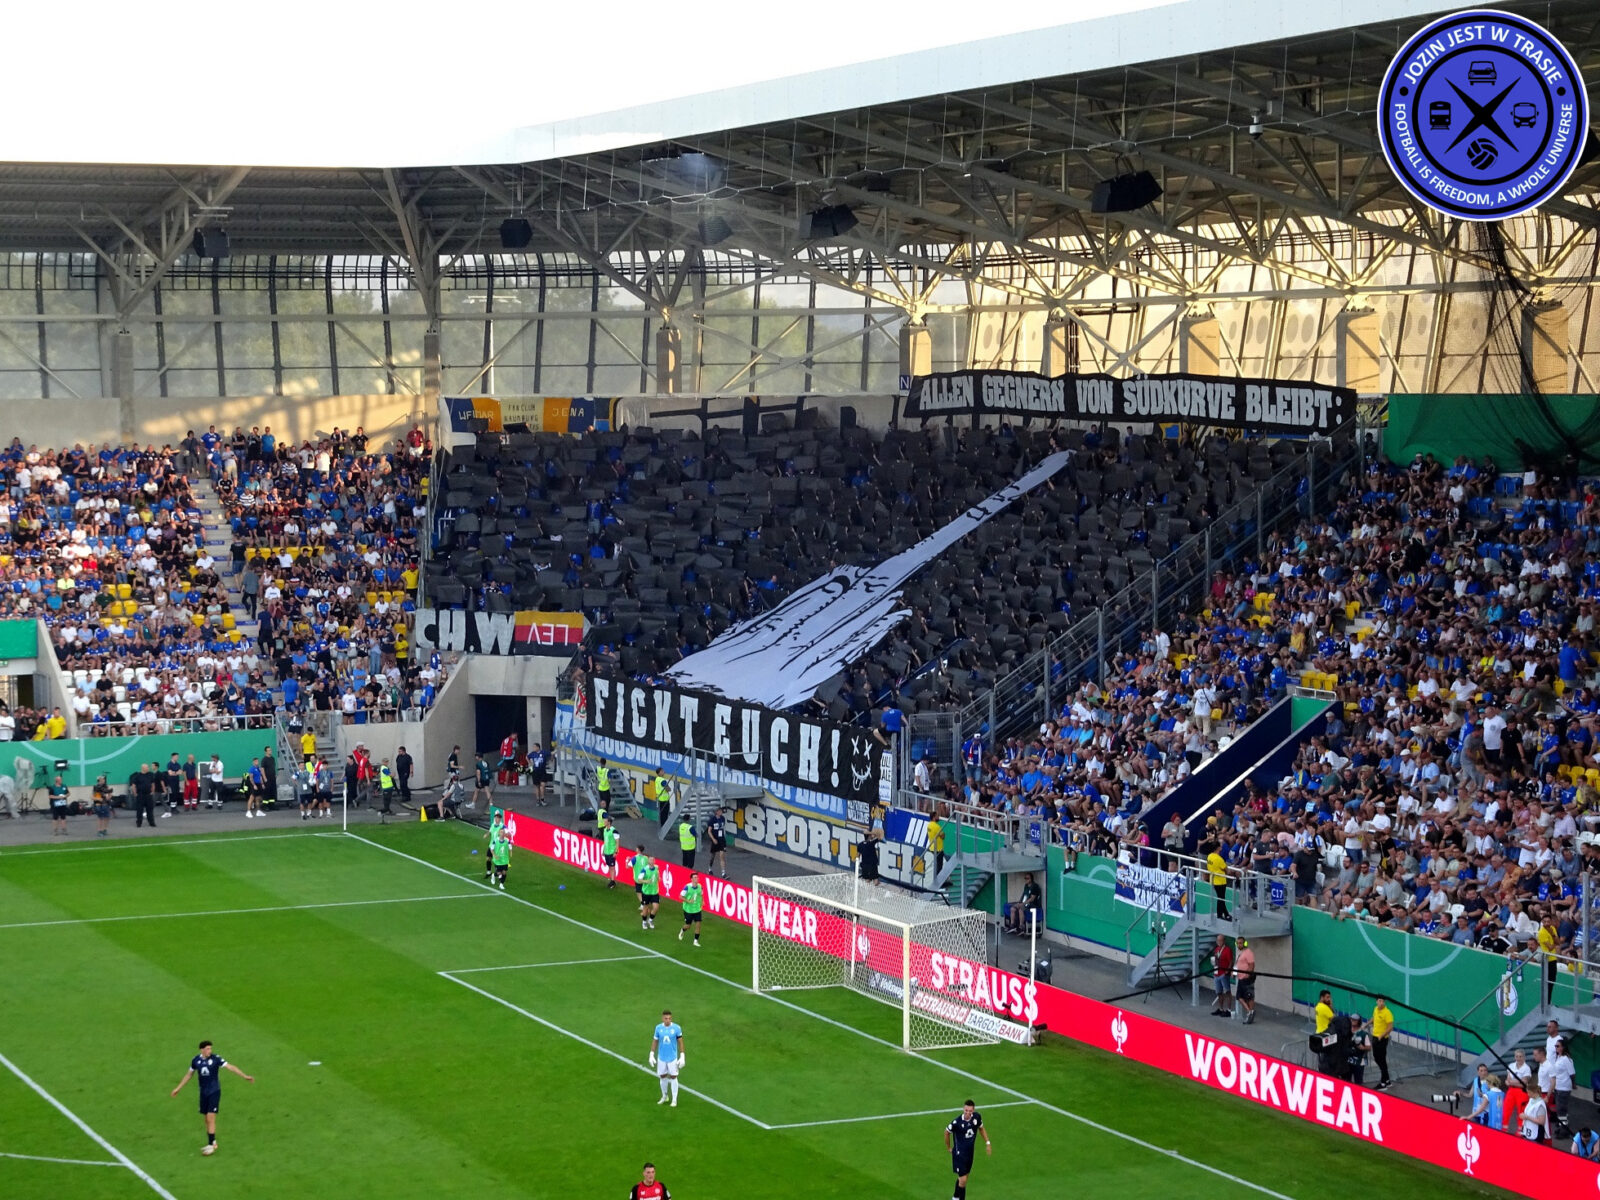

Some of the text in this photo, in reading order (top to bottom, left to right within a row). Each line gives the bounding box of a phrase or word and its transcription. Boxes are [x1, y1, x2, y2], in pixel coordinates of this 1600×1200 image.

[552, 407, 585, 417] JENA
[919, 373, 1343, 428] ALLEN GEGNERN VON SÜDKURVE BLEIBT:
[593, 677, 699, 749] FICKT
[714, 703, 841, 789] EUCH!
[553, 828, 619, 878] STRAUS
[705, 876, 818, 948] WORKWEAR
[1271, 887, 1284, 899] C17
[931, 952, 1039, 1022] STRAUSS
[1184, 1033, 1384, 1142] WORKWEAR
